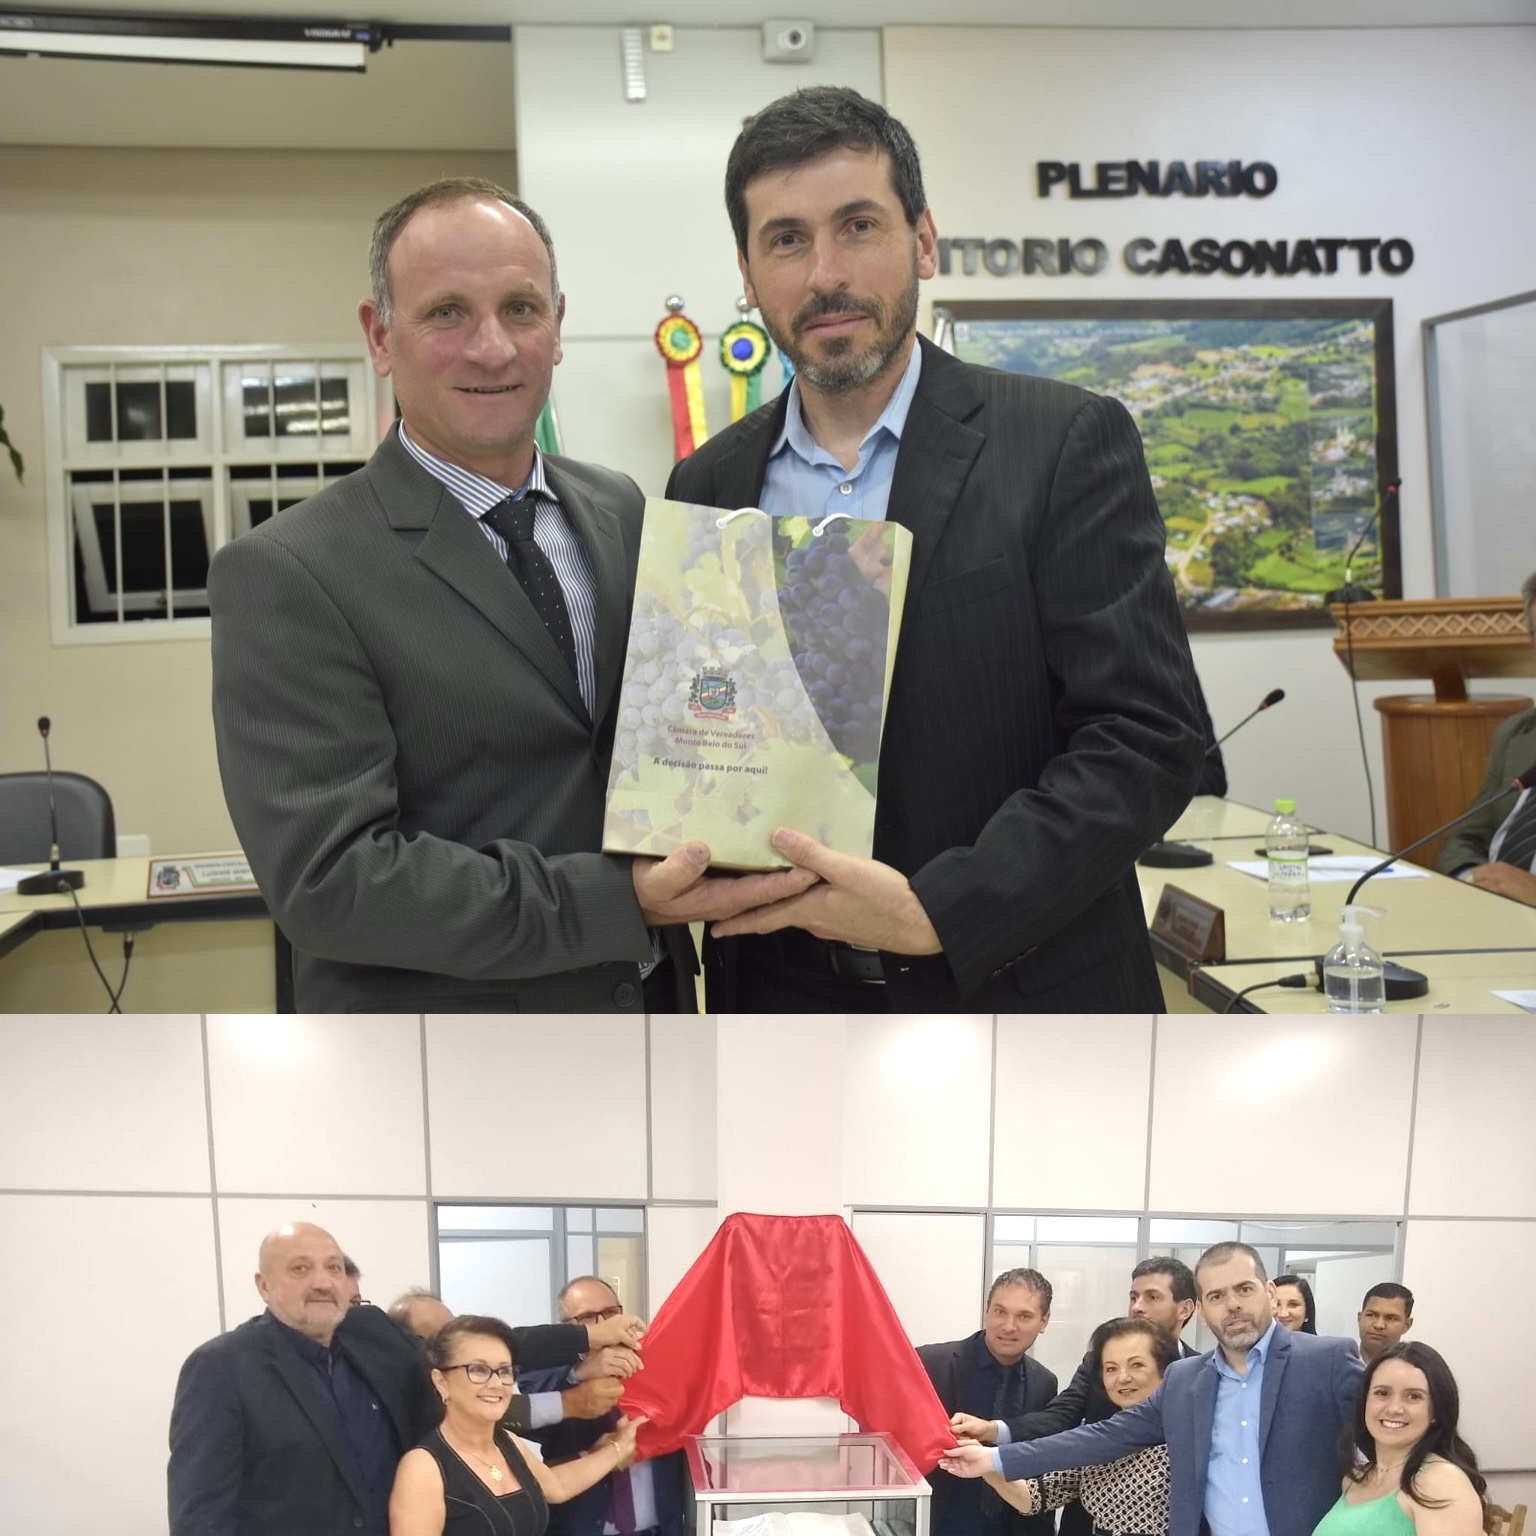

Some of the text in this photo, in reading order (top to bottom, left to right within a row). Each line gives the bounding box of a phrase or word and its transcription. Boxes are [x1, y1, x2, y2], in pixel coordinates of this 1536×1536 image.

[1037, 160, 1278, 198] PLENARIO
[938, 238, 1415, 276] ITORIO CASONATTO
[698, 728, 709, 736] de
[710, 729, 755, 740] Vereadores
[674, 737, 701, 746] Monte
[722, 741, 732, 749] do
[734, 742, 747, 750] Sul
[653, 757, 768, 775] A decisão passa por aqui!
